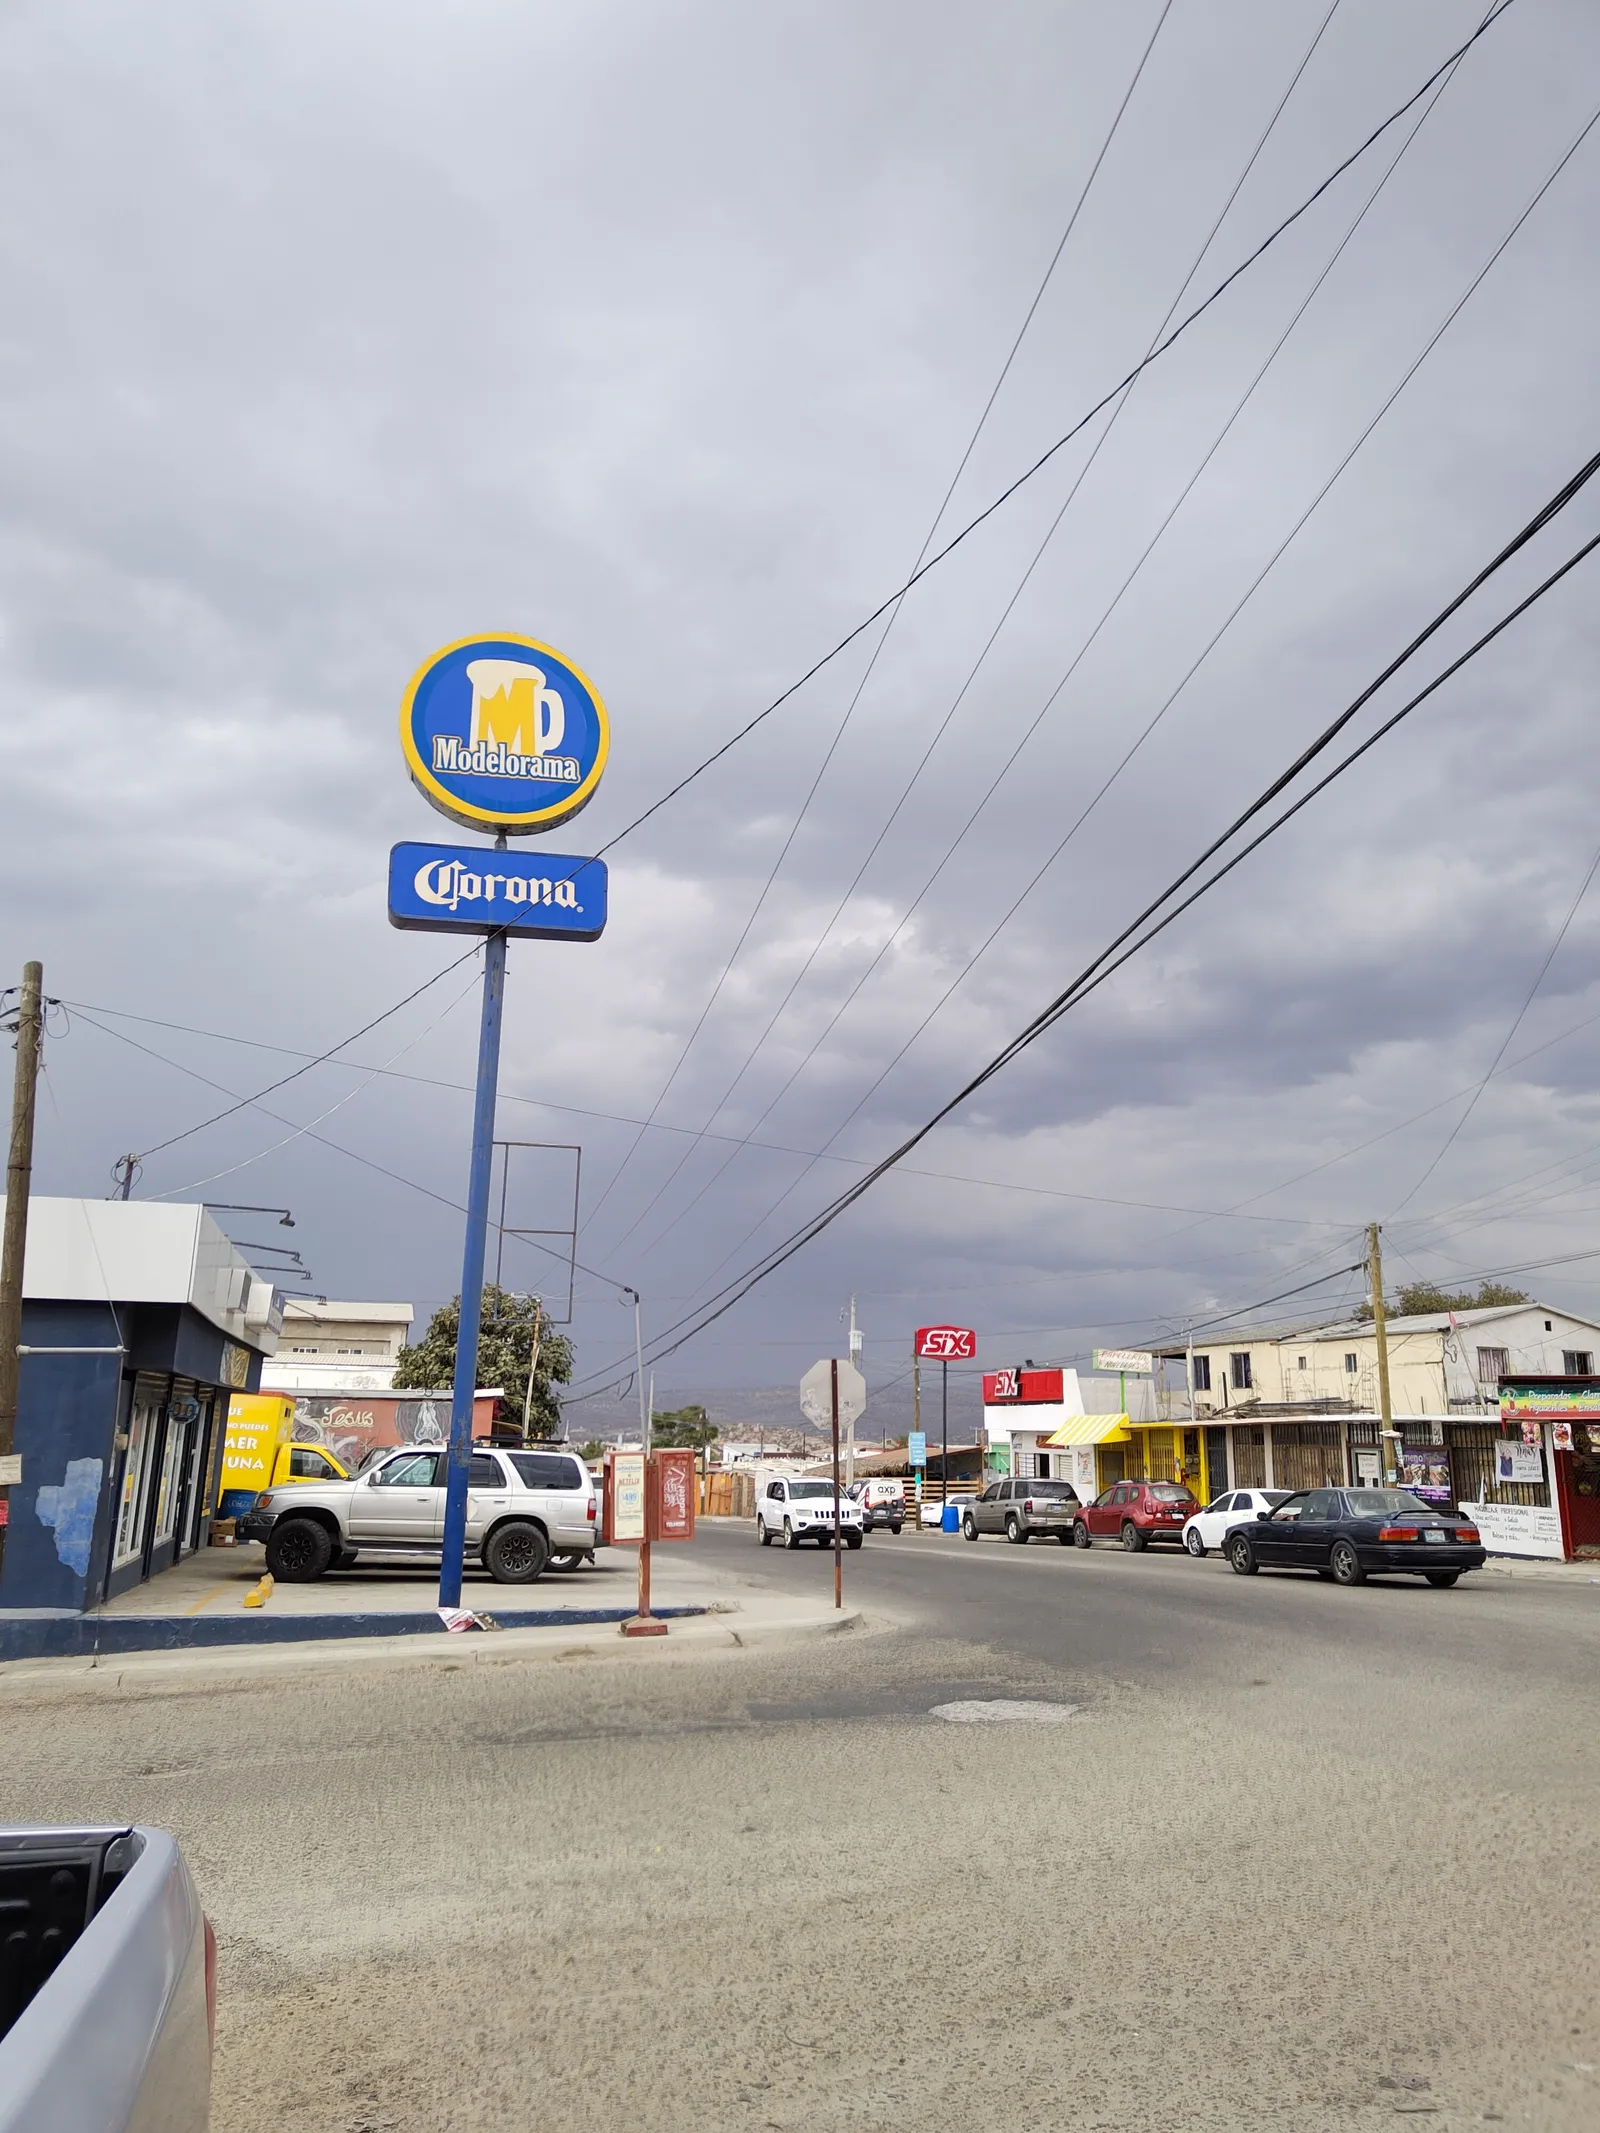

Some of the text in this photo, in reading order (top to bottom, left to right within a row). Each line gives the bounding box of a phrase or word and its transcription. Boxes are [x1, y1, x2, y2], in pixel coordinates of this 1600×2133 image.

[434, 735, 579, 782] Modelorama
[414, 859, 579, 911] Corona
[1528, 1389, 1571, 1401] Preparadas
[1528, 1403, 1568, 1414] Aguachiles
[239, 1422, 269, 1431] PUEDES
[227, 1456, 265, 1470] UNA
[877, 1486, 896, 1496] axp
[678, 1484, 686, 1519] Ladatel
[1500, 1507, 1529, 1516] PROFESIONAL
